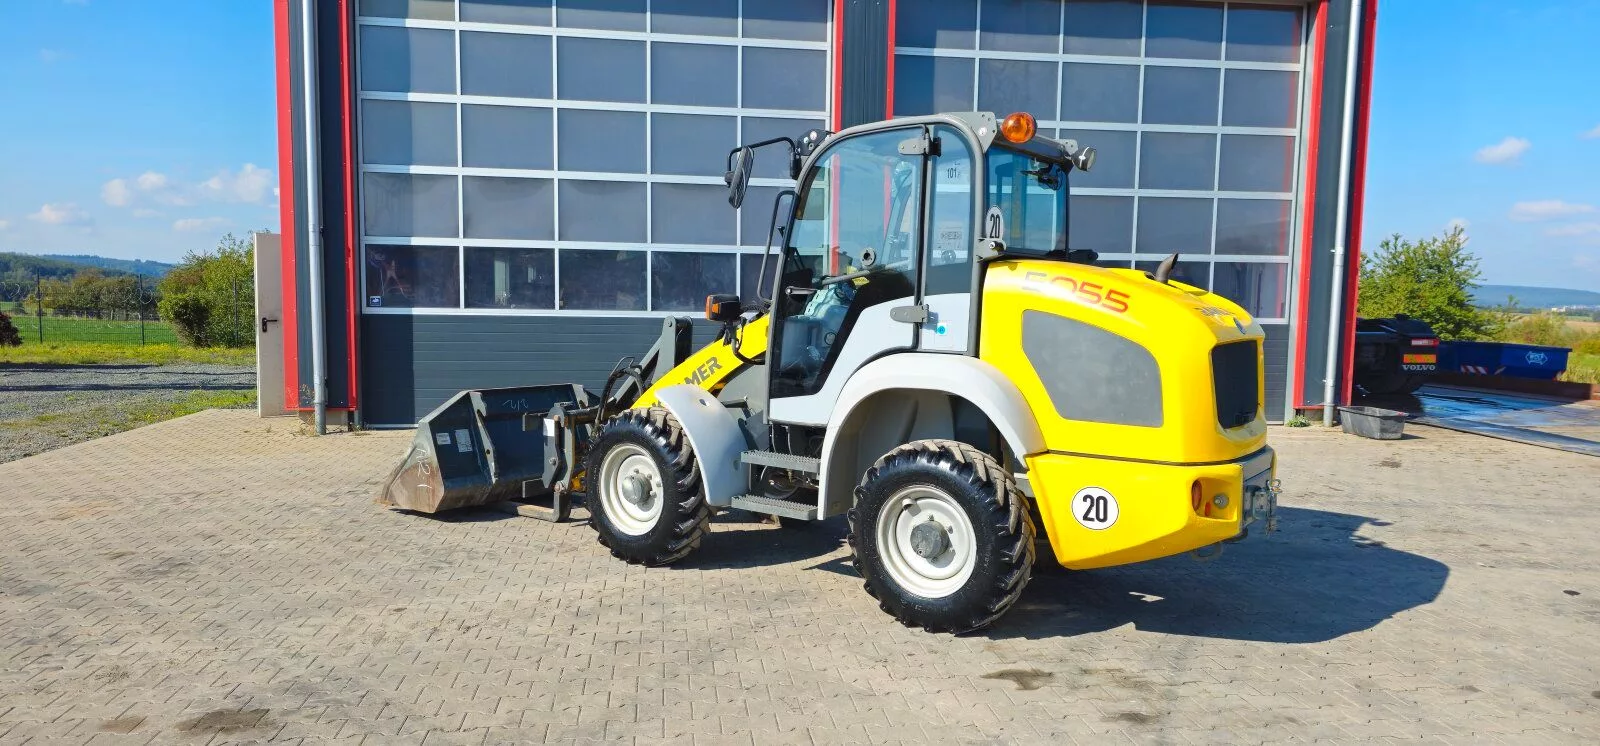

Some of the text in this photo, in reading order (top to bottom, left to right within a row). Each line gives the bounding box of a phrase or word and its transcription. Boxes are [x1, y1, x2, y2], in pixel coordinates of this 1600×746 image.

[947, 168, 957, 179] 101
[990, 213, 1001, 239] 20
[1082, 494, 1108, 523] 20
